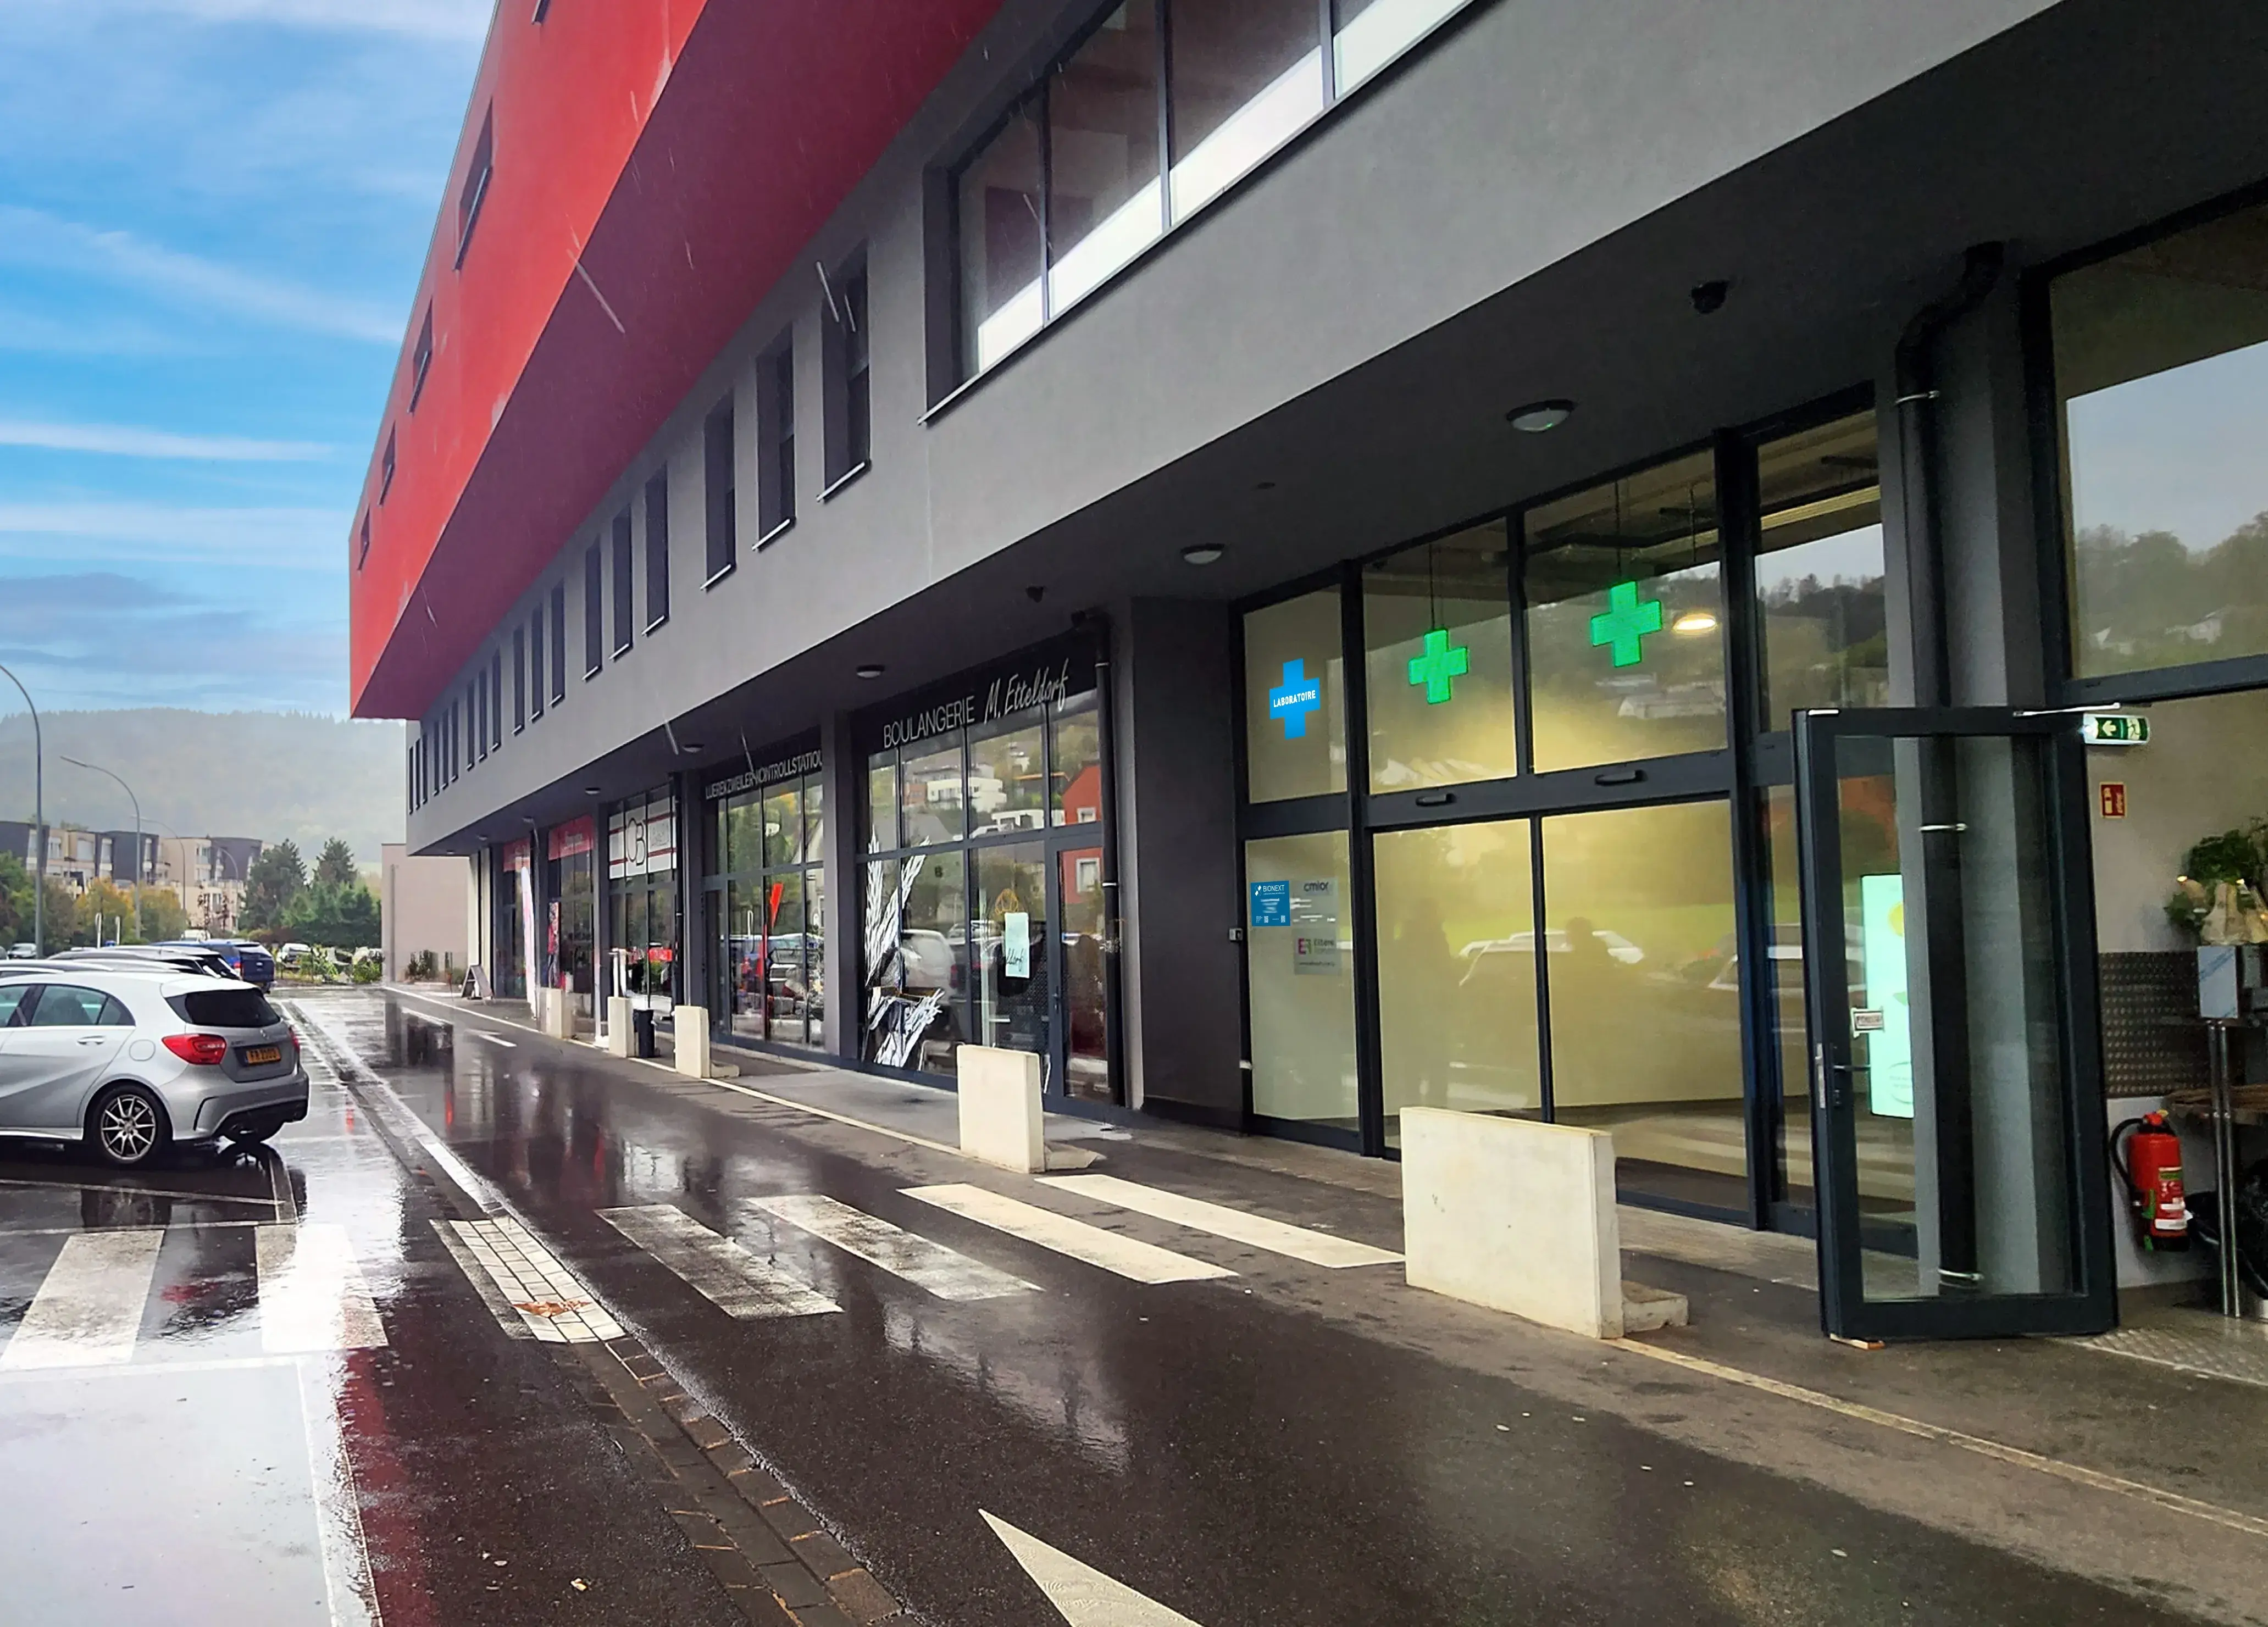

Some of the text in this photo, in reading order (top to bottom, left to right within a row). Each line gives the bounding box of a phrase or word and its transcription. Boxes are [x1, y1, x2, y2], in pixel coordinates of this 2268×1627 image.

[884, 658, 1069, 748] BOULANGERIE M. Etteldorf
[1273, 690, 1316, 708] LABORATOIRE
